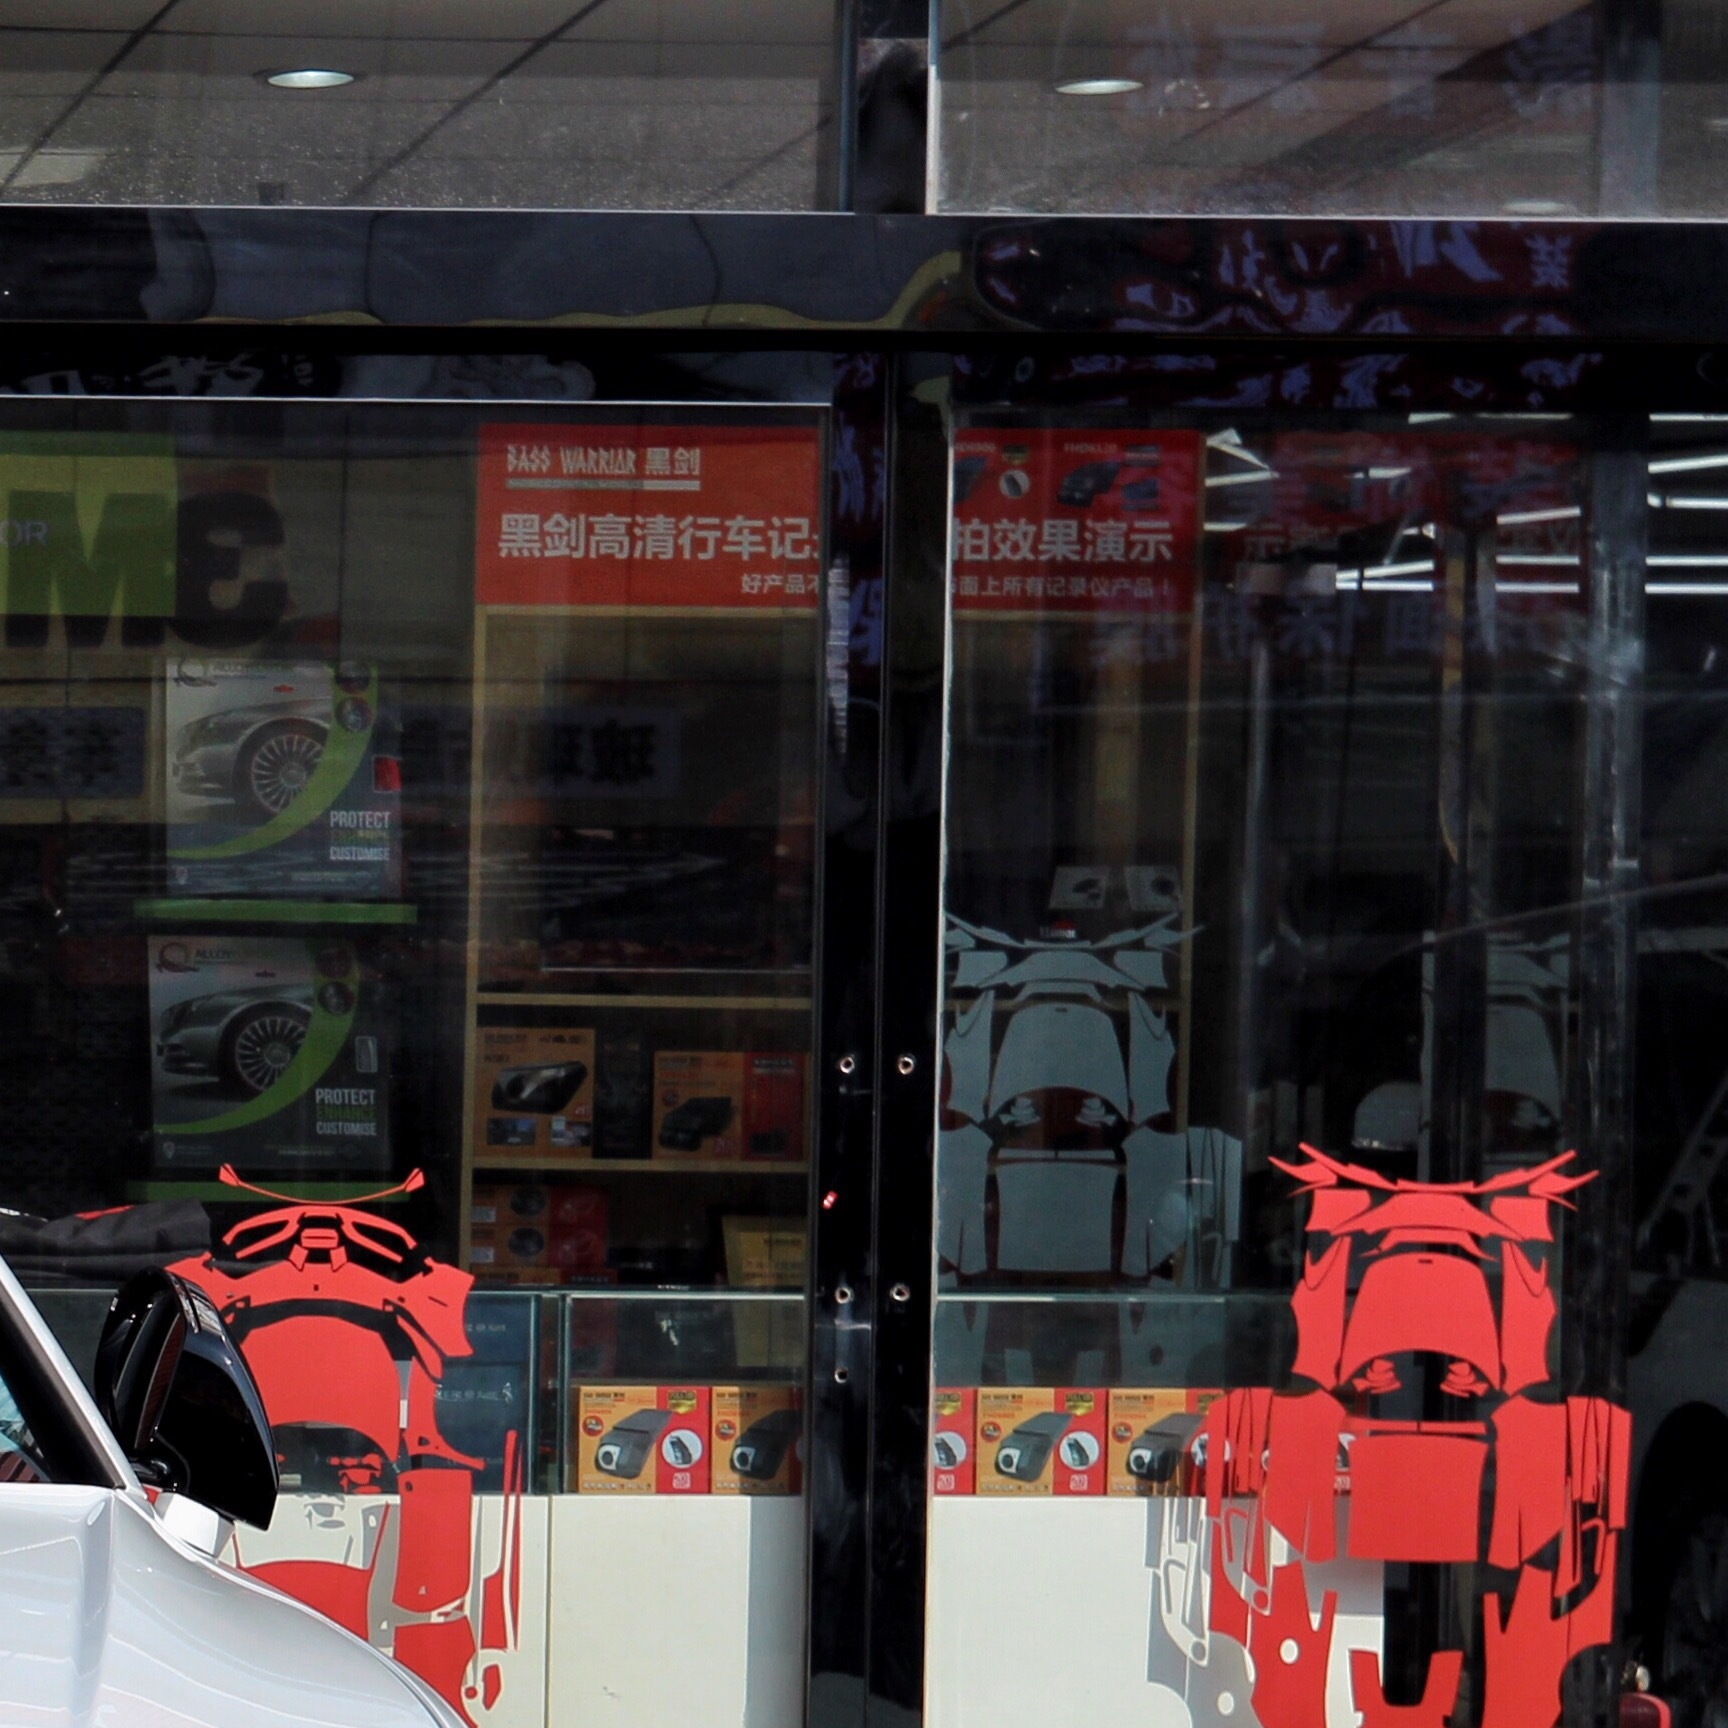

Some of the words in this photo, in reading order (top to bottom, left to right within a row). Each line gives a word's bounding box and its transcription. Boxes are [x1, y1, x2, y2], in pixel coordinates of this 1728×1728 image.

[644, 447, 700, 475] 黑剑
[498, 513, 819, 561] 黑剑高清行车记
[950, 574, 1171, 599] 面上所有记录仪产品！
[329, 810, 391, 829] PROTECT
[314, 1087, 377, 1105] PROTECT
[315, 1121, 377, 1137] CUSTOMISE
